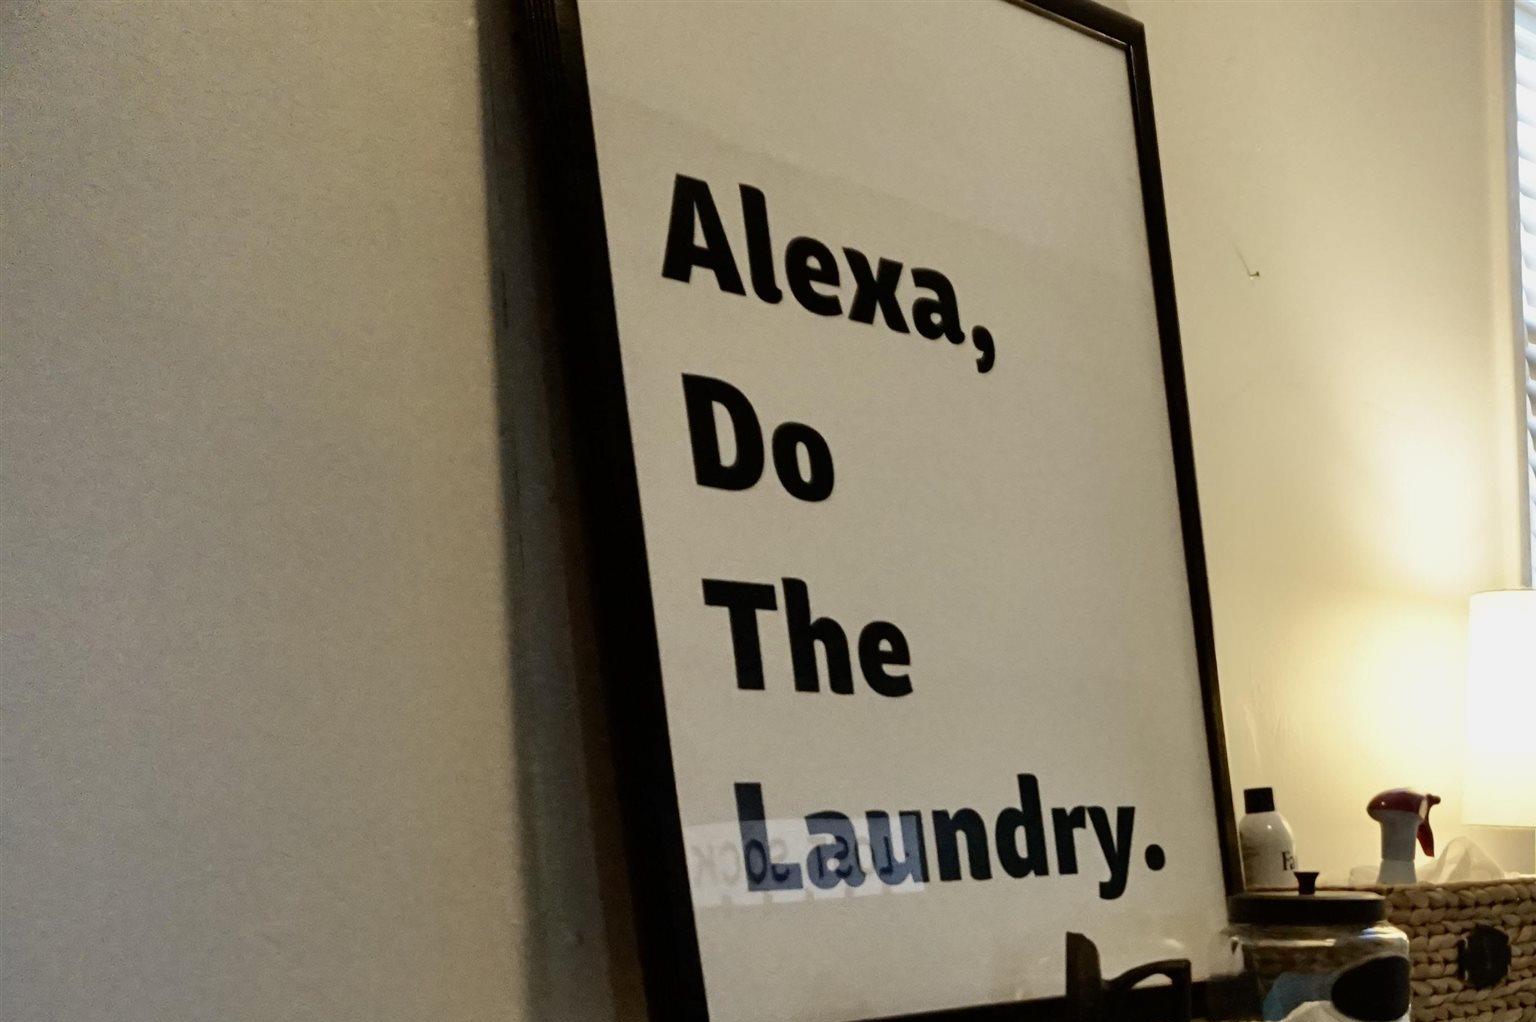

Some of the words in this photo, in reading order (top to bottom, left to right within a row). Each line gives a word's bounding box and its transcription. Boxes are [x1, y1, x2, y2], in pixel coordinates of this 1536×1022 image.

[661, 173, 996, 374] Alexa,
[681, 372, 835, 503] Do
[701, 577, 914, 698] The
[733, 772, 1167, 901] Laundry.
